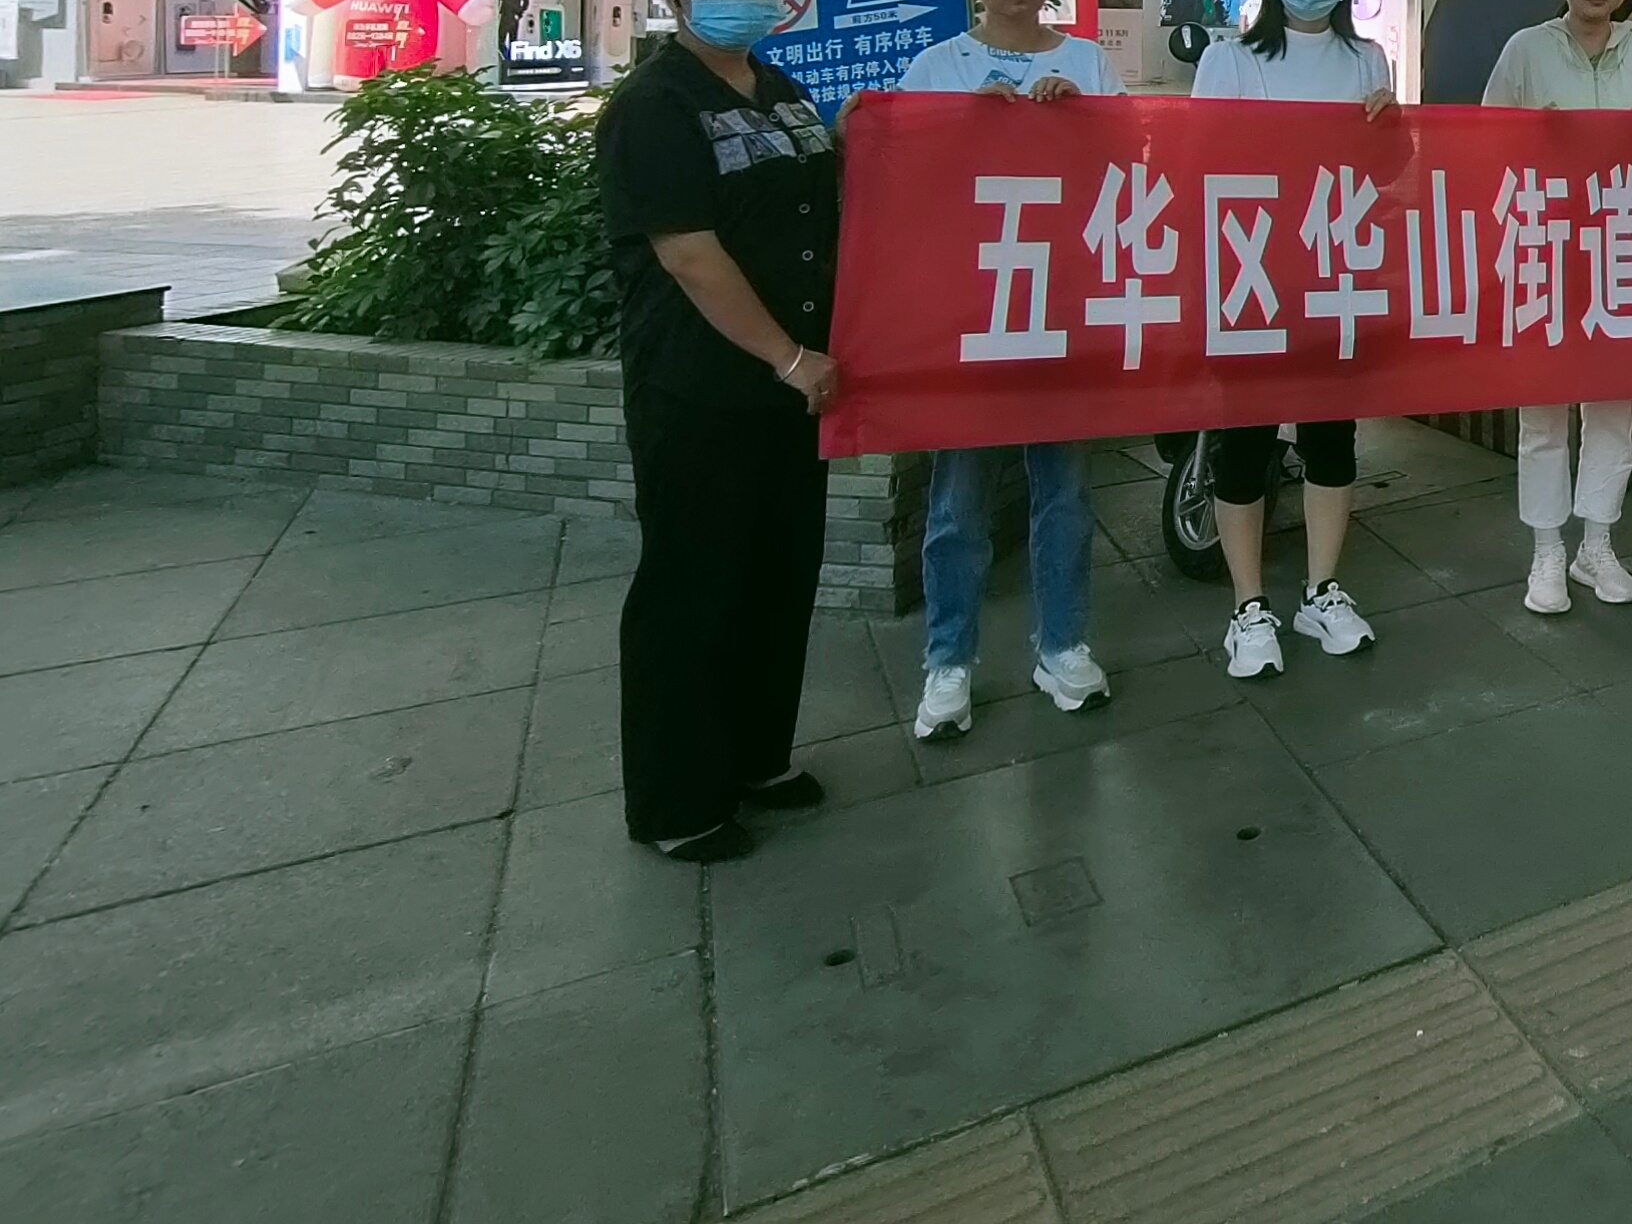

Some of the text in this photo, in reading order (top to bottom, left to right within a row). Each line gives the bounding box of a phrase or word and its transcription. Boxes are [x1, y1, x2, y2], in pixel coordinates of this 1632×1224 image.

[350, 0, 410, 15] HUAWEI
[851, 9, 899, 25] 前方50米
[510, 39, 583, 61] Find X6
[766, 25, 934, 68] 文明出行 有序停车
[791, 55, 916, 85] 机动车有序停入停
